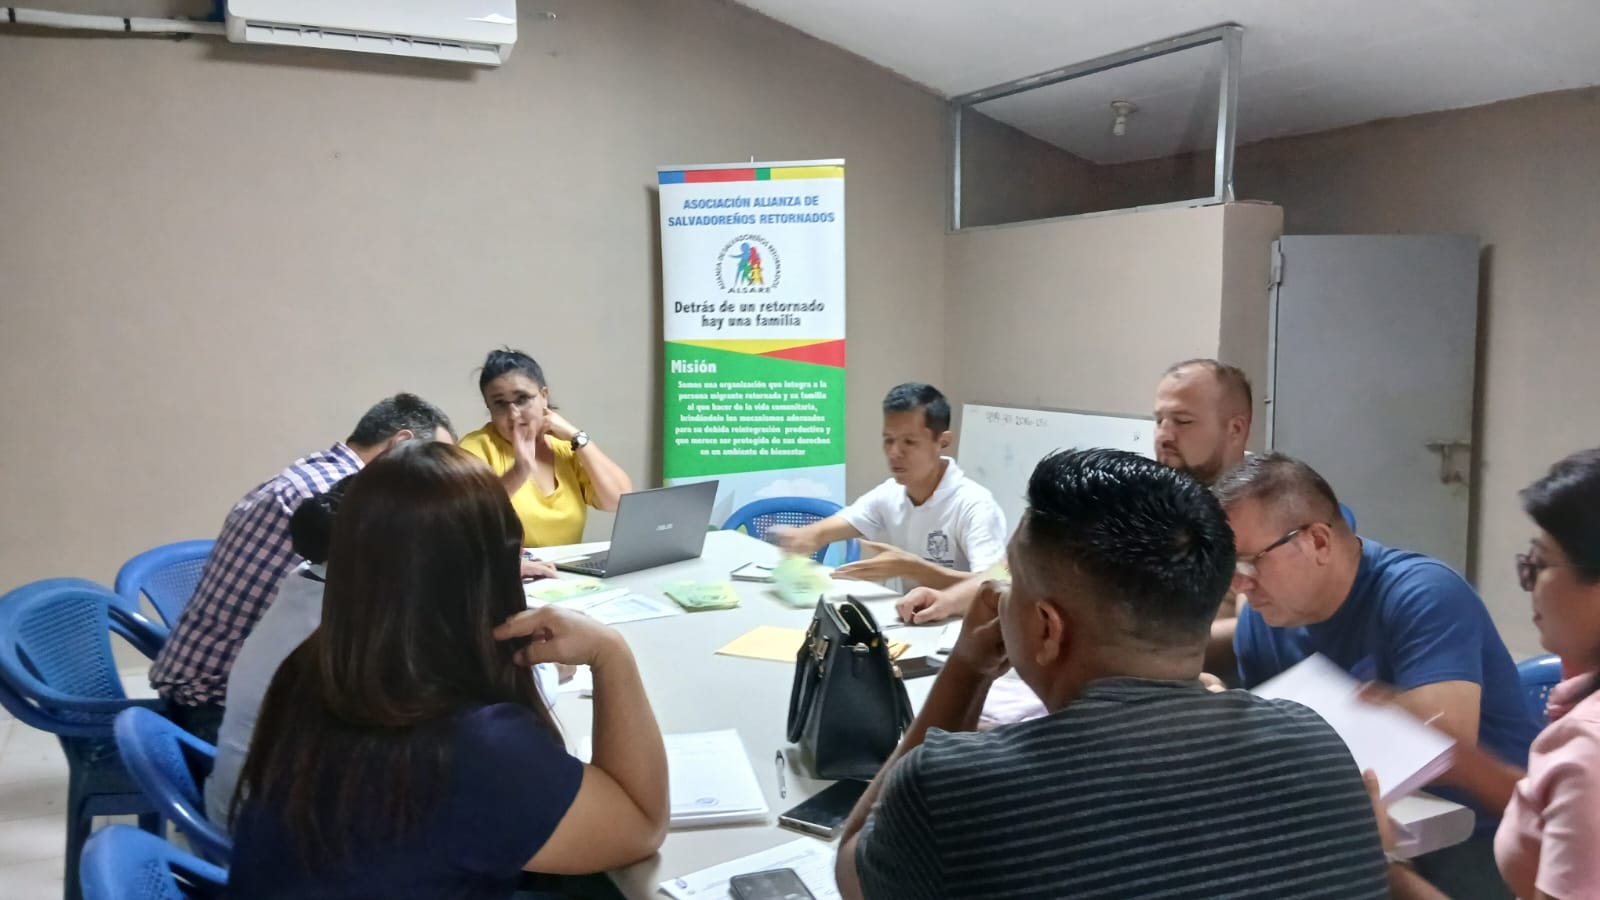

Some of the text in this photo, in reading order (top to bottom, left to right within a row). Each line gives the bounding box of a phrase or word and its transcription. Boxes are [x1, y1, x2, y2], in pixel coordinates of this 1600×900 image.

[683, 195, 819, 210] ASOCIACIÓN ALIANZA DE
[668, 212, 835, 227] SALVADOREÑOS RETORNADOS
[674, 299, 825, 313] Detrás de un retornado
[701, 313, 801, 331] hay una familia
[671, 360, 717, 374] Misión
[768, 382, 782, 390] que
[820, 380, 827, 388] la
[783, 393, 788, 401] y
[801, 391, 827, 399] familia
[696, 405, 710, 413] que
[734, 403, 743, 411] de
[745, 403, 752, 411] la
[754, 403, 770, 411] vida
[825, 427, 831, 435] y
